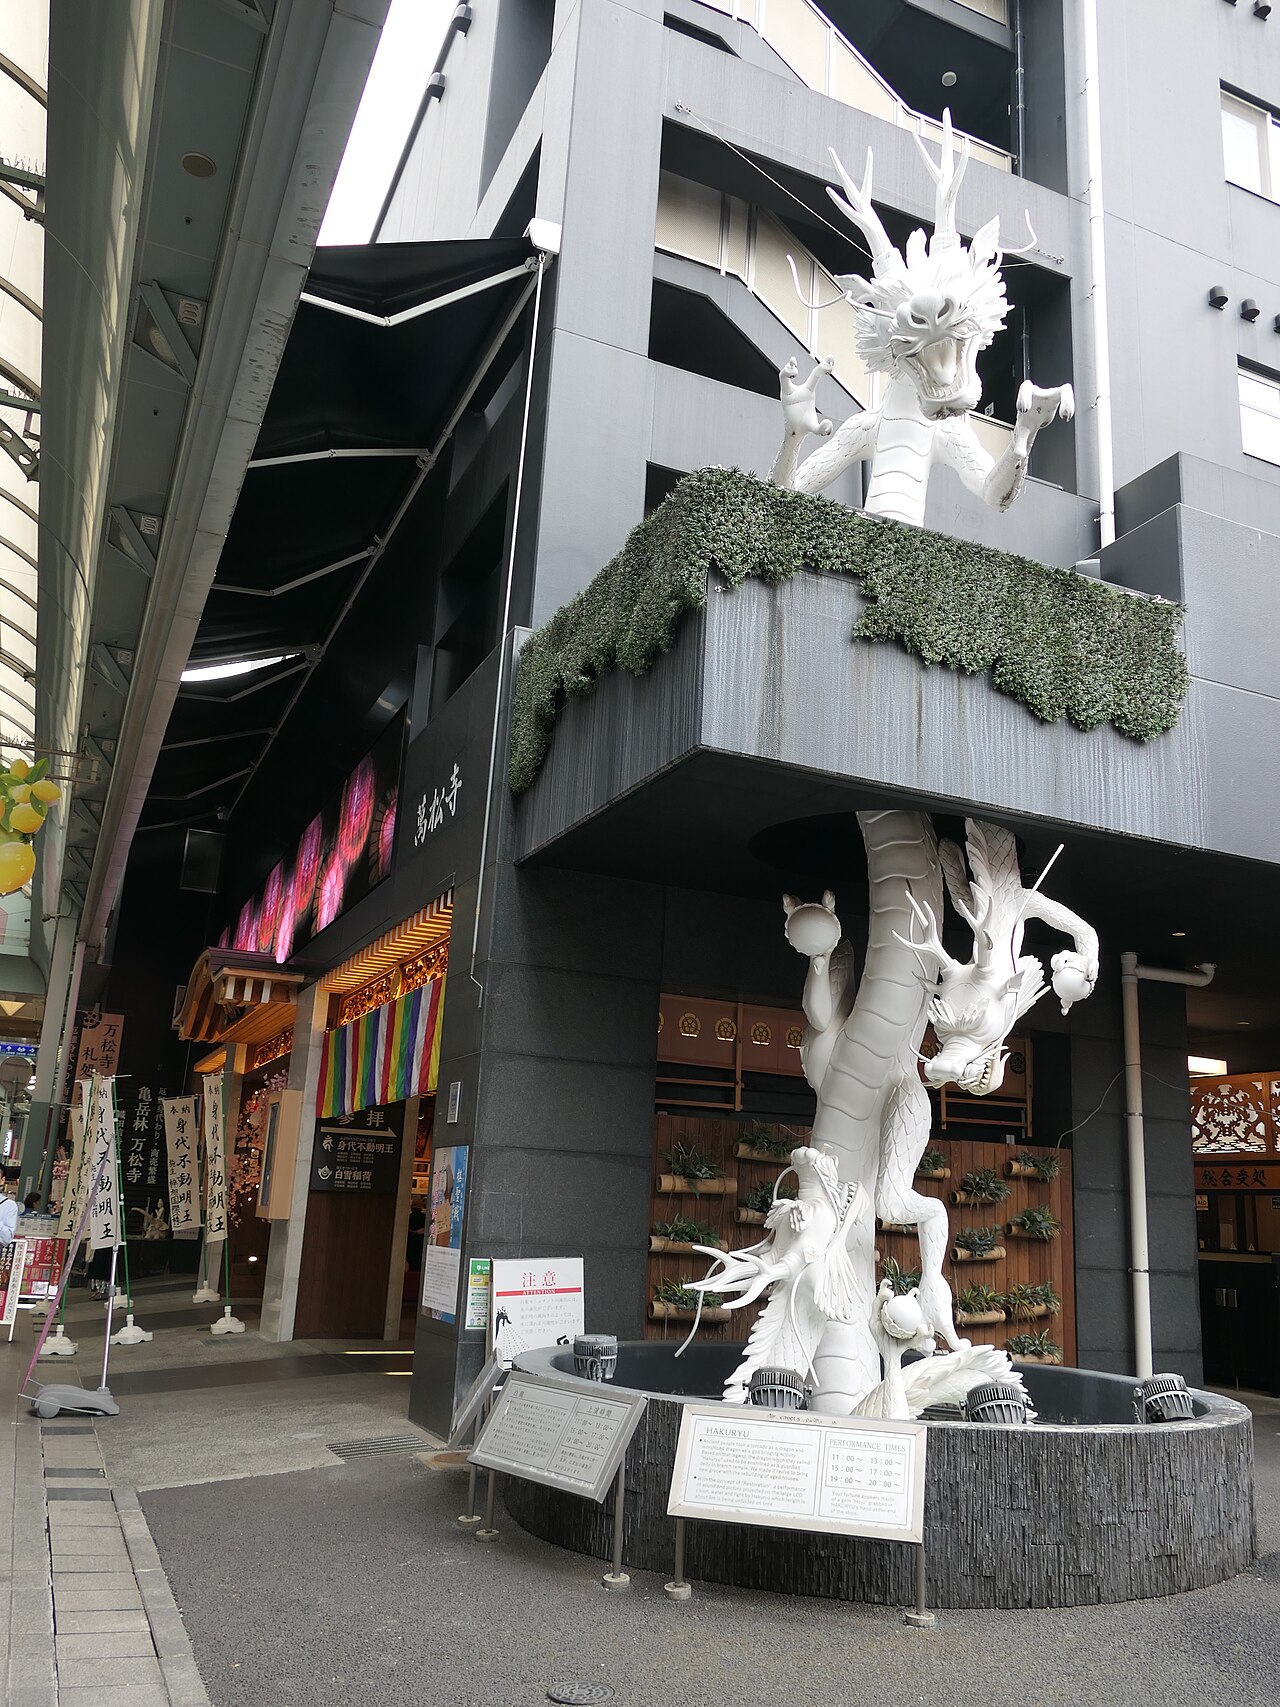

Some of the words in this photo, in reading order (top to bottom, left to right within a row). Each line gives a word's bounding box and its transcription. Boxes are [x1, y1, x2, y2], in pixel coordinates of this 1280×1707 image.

[99, 1024, 119, 1069] 万松寺
[337, 1140, 394, 1153] 身代不動明王
[126, 1138, 146, 1183] 万松寺
[175, 1117, 192, 1223] 身代不動明王
[1202, 1168, 1266, 1187] 総合受処
[523, 1270, 556, 1287] 注意
[522, 1288, 556, 1296] ATTENTION
[706, 1426, 750, 1437] HAKURYU
[829, 1438, 881, 1449] PERFORMANCE
[884, 1443, 905, 1452] TIMES
